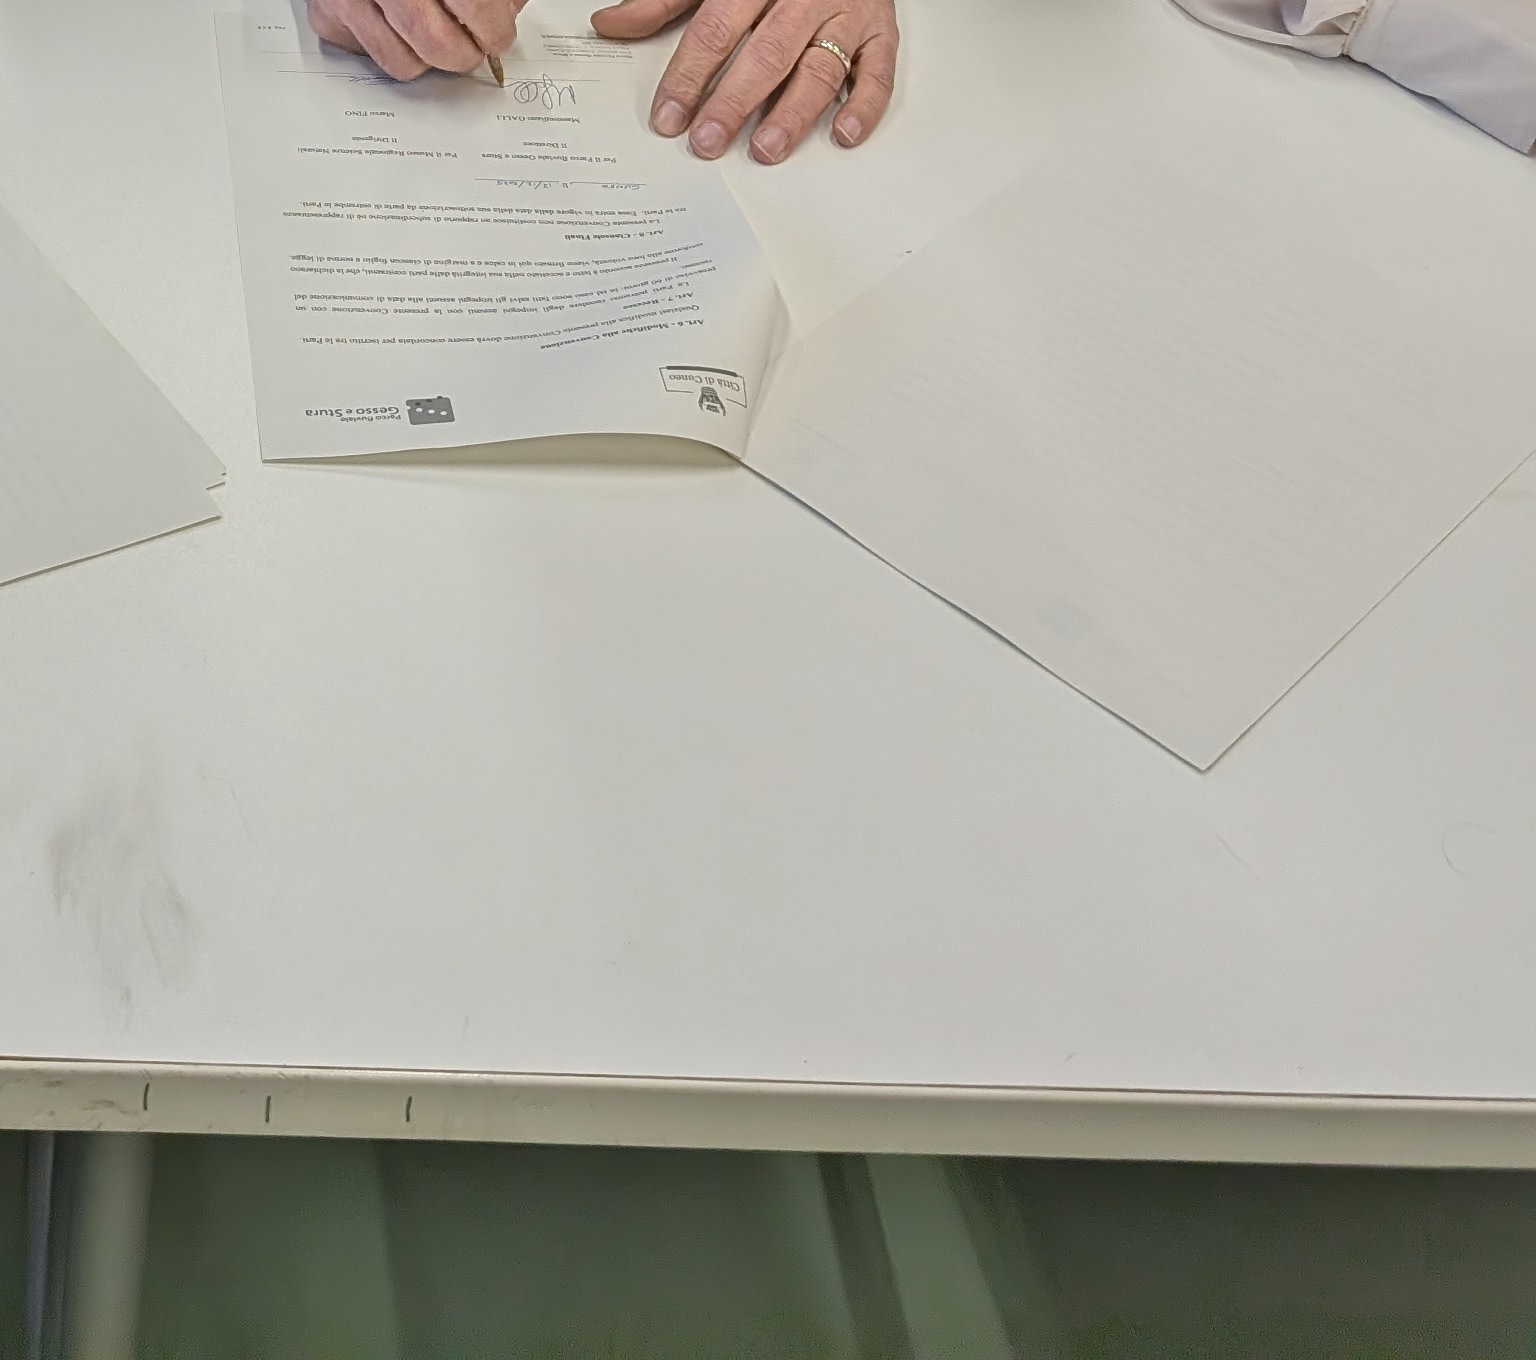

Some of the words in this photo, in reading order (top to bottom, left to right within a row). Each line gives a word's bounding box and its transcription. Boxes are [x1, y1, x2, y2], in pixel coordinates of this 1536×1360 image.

[496, 114, 526, 122] GALLI
[527, 116, 581, 124] Massimiliano
[352, 135, 389, 144] Dirigente
[523, 141, 559, 149] Direttore
[297, 147, 330, 155] Naturali
[331, 148, 363, 156] Scienze
[364, 149, 405, 157] Regionale
[406, 150, 434, 158] Museo
[511, 153, 537, 161] Gesso
[537, 154, 568, 162] fluviale
[299, 201, 322, 209] Parti.
[406, 204, 417, 212] da
[418, 205, 476, 213] sottoscrizione
[282, 211, 344, 219] rappresentanza
[493, 207, 513, 215] della
[533, 208, 555, 216] dalla
[556, 208, 583, 216] vigore
[346, 213, 355, 221] di
[368, 214, 431, 223] subordinazione
[612, 218, 647, 226] presente
[592, 233, 631, 241] Clausole
[674, 292, 694, 300] Art.
[658, 304, 700, 316] Qualsiasi
[618, 311, 658, 322] modifica
[562, 321, 599, 333] presente
[621, 322, 669, 334] Modifiche
[503, 330, 562, 341] Convenzione
[601, 330, 619, 338] alla
[299, 337, 323, 345] Parti.
[324, 337, 333, 345] le
[476, 336, 502, 344] dovrà
[540, 334, 600, 350] Convenzione
[668, 373, 703, 384] Cuneo
[704, 376, 715, 385] di
[716, 377, 740, 392] Città
[304, 408, 343, 418] Stura
[355, 406, 400, 415] Gesso
[340, 415, 374, 423] fluviale
